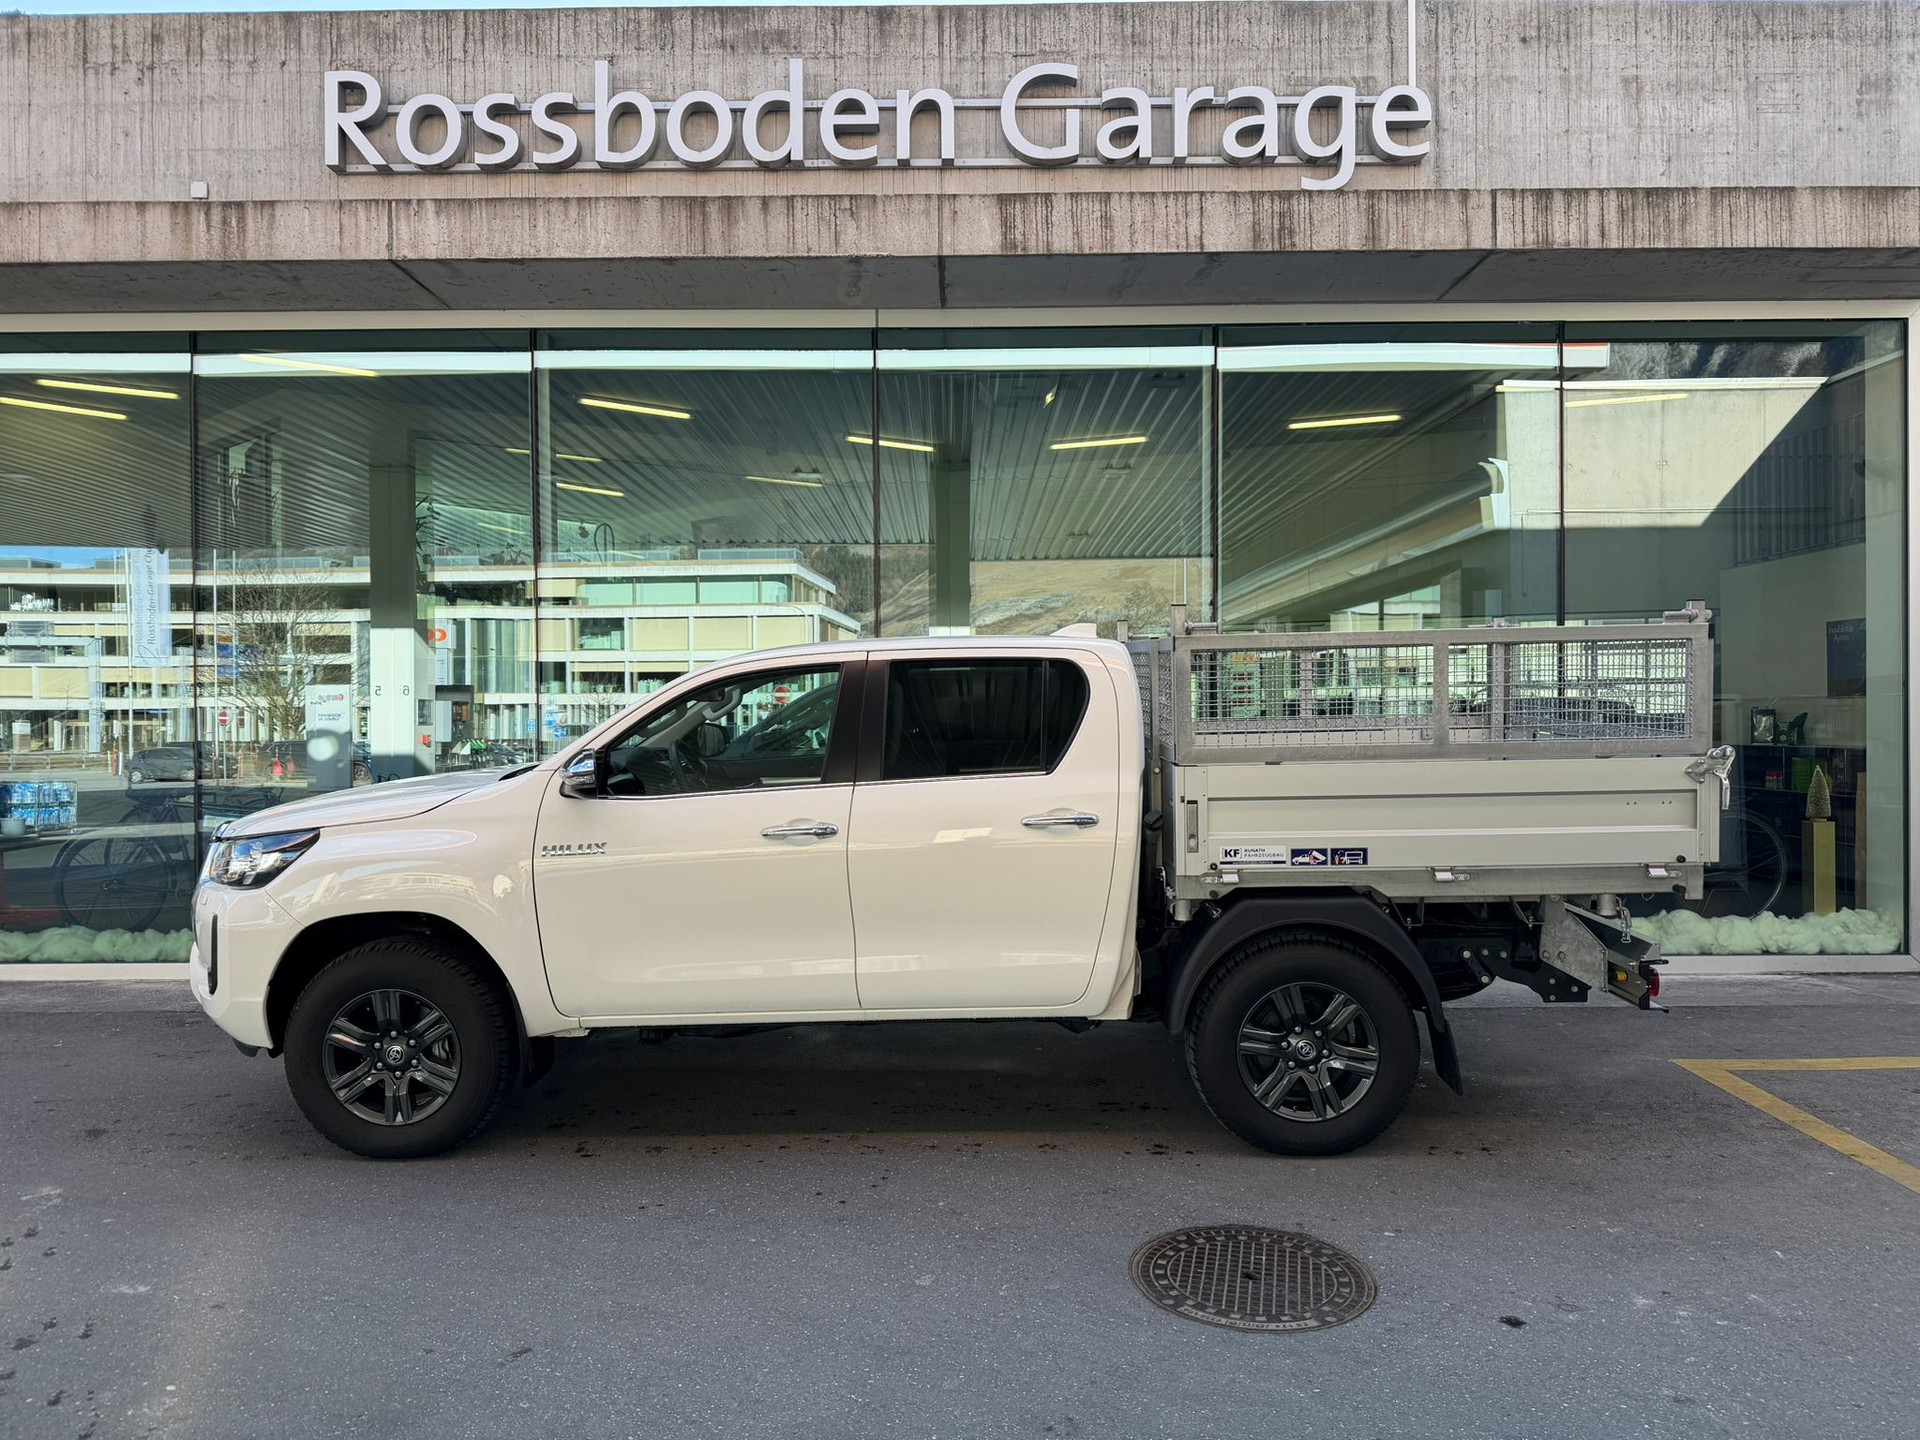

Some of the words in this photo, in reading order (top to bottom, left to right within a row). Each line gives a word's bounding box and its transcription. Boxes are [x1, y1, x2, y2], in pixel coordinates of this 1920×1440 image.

[324, 58, 955, 168] Rossboden
[1000, 62, 1433, 191] Garage
[541, 842, 607, 857] HILUX
